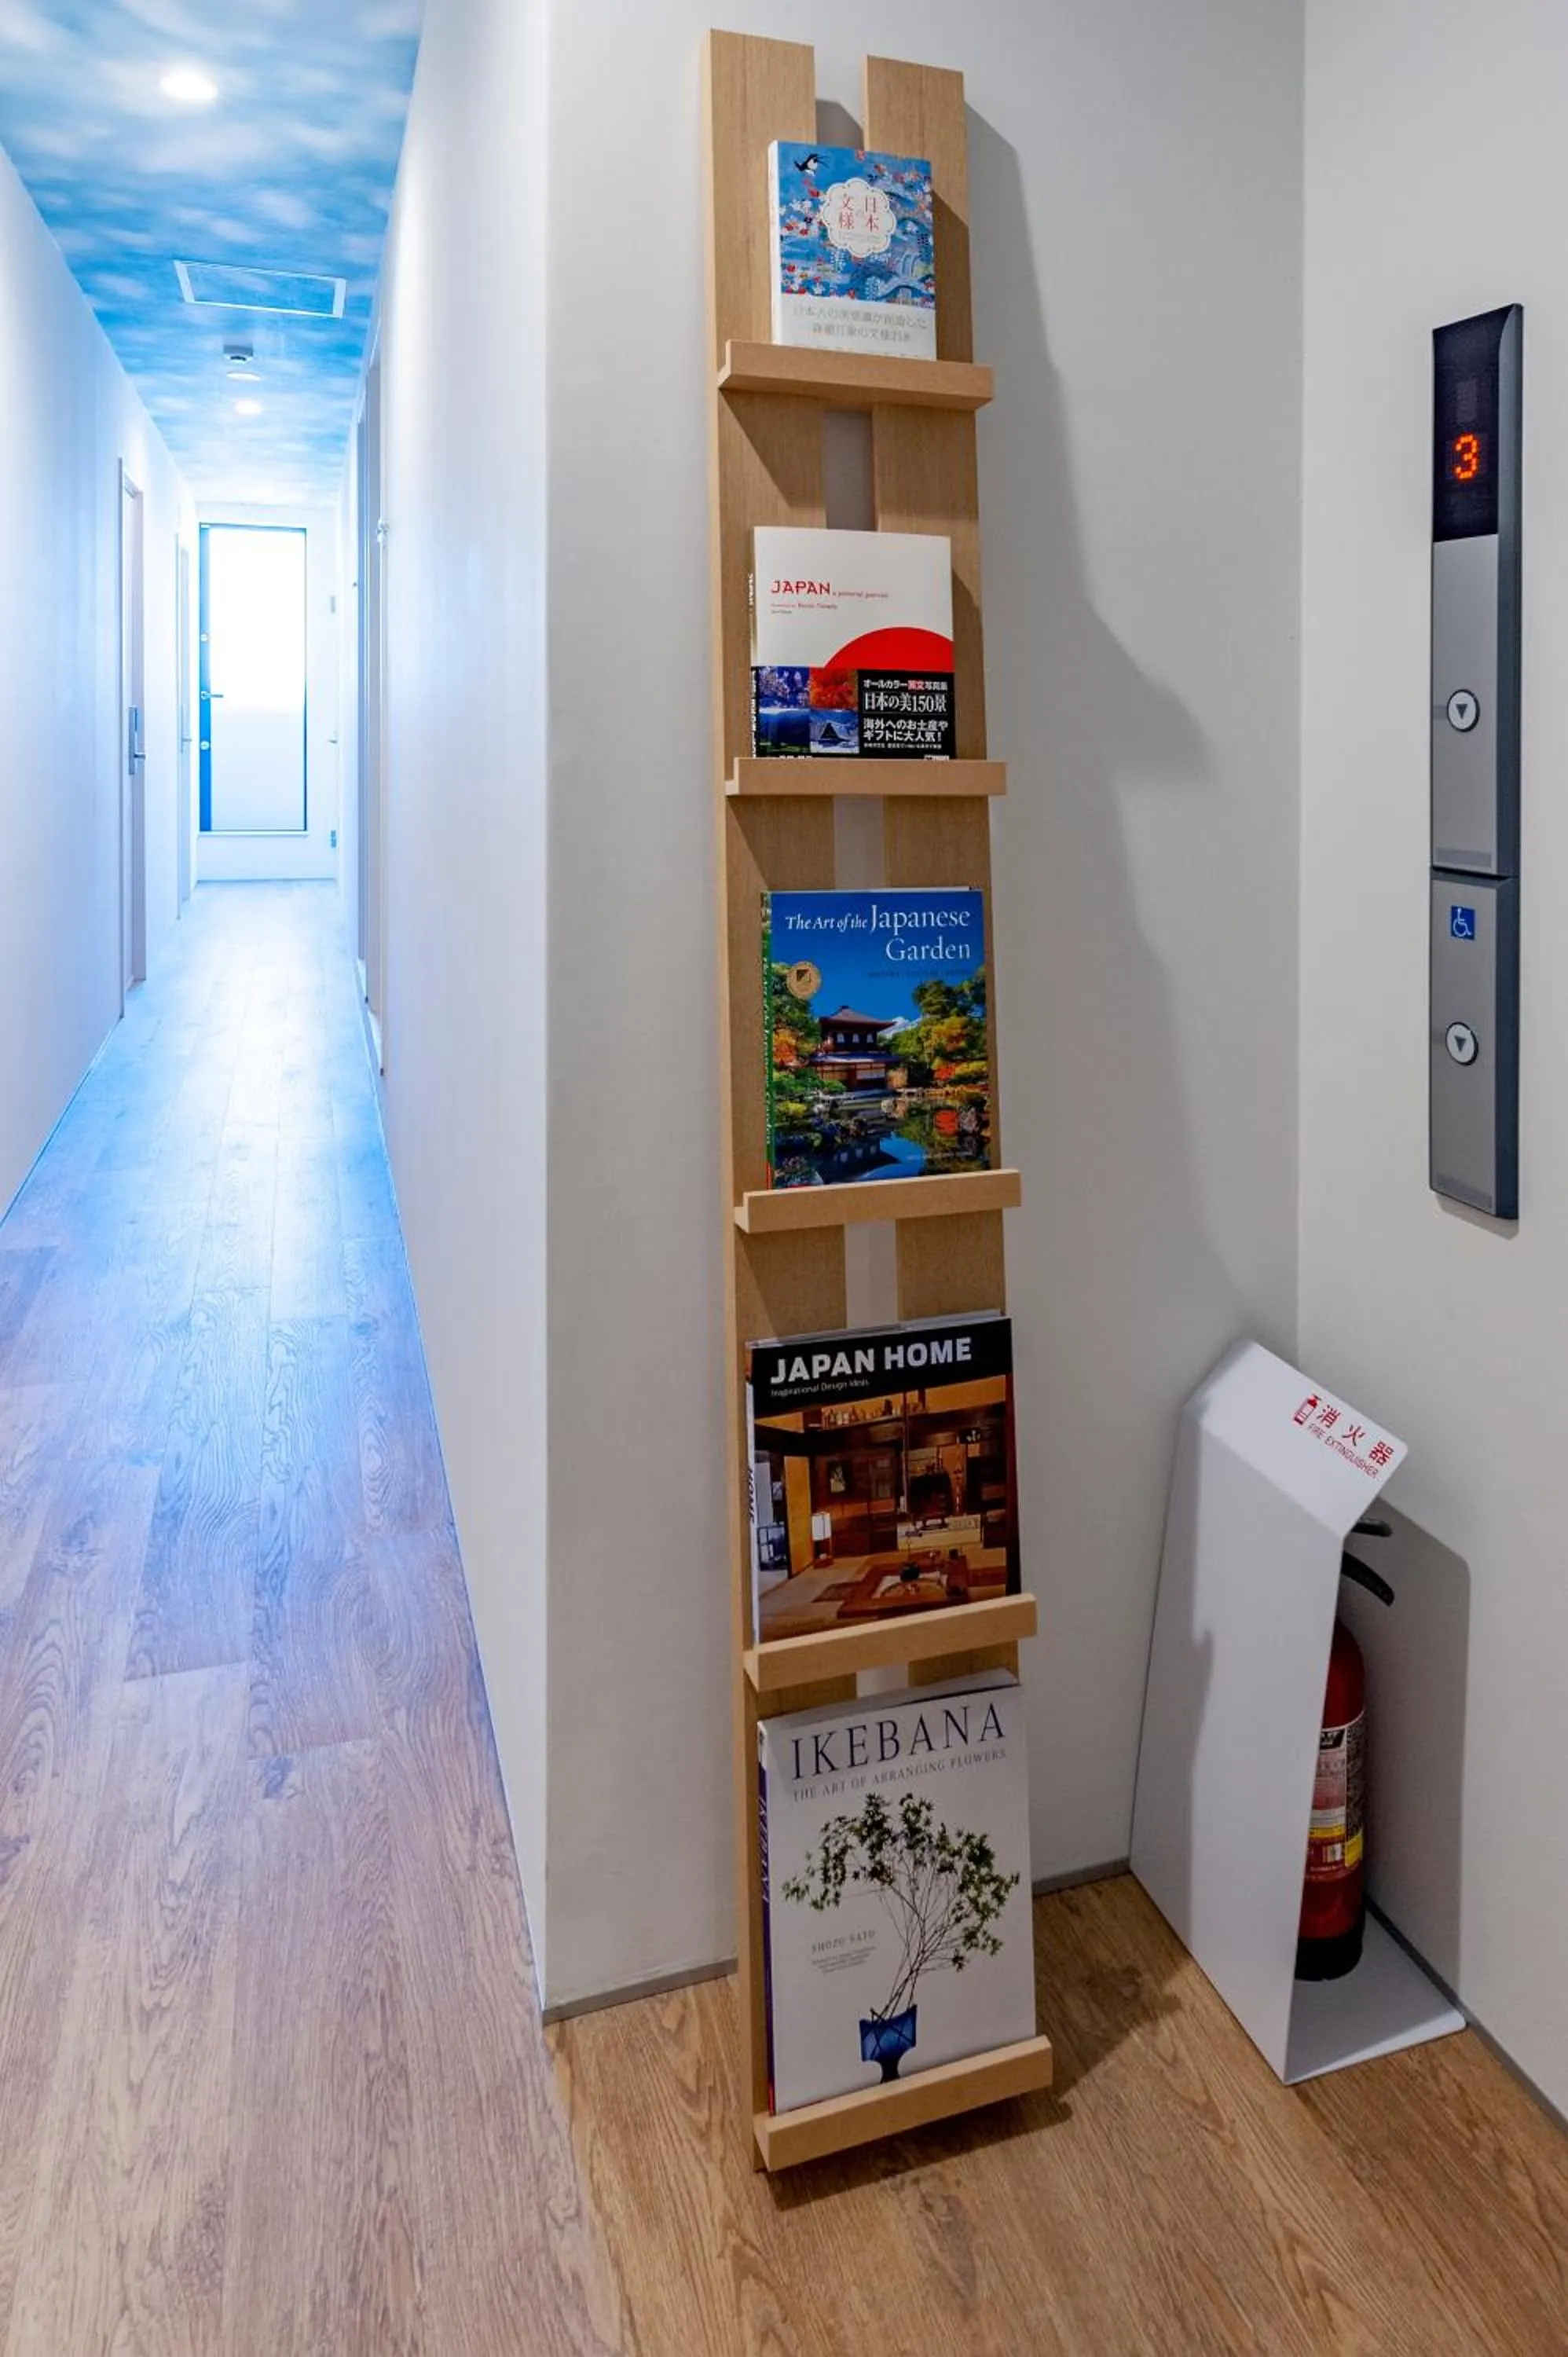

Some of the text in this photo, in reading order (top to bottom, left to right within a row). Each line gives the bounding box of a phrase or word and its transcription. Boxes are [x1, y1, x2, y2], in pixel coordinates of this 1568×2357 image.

[1455, 433, 1478, 480] 3
[771, 580, 830, 595] JAPAN
[864, 692, 947, 713] 日本の美150景
[863, 717, 948, 732] 海外へのお土産や
[786, 904, 971, 936] The Art of the Japanese
[885, 935, 971, 961] Garden
[770, 1336, 972, 1384] JAPAN HOME
[1316, 1404, 1394, 1467] 消火器
[791, 1702, 1006, 1781] IKEBANA
[793, 1785, 816, 1802] THE
[823, 1780, 847, 1798] ART
[873, 1761, 946, 1786] ARRANGING
[949, 1748, 1008, 1769] FLOWERS
